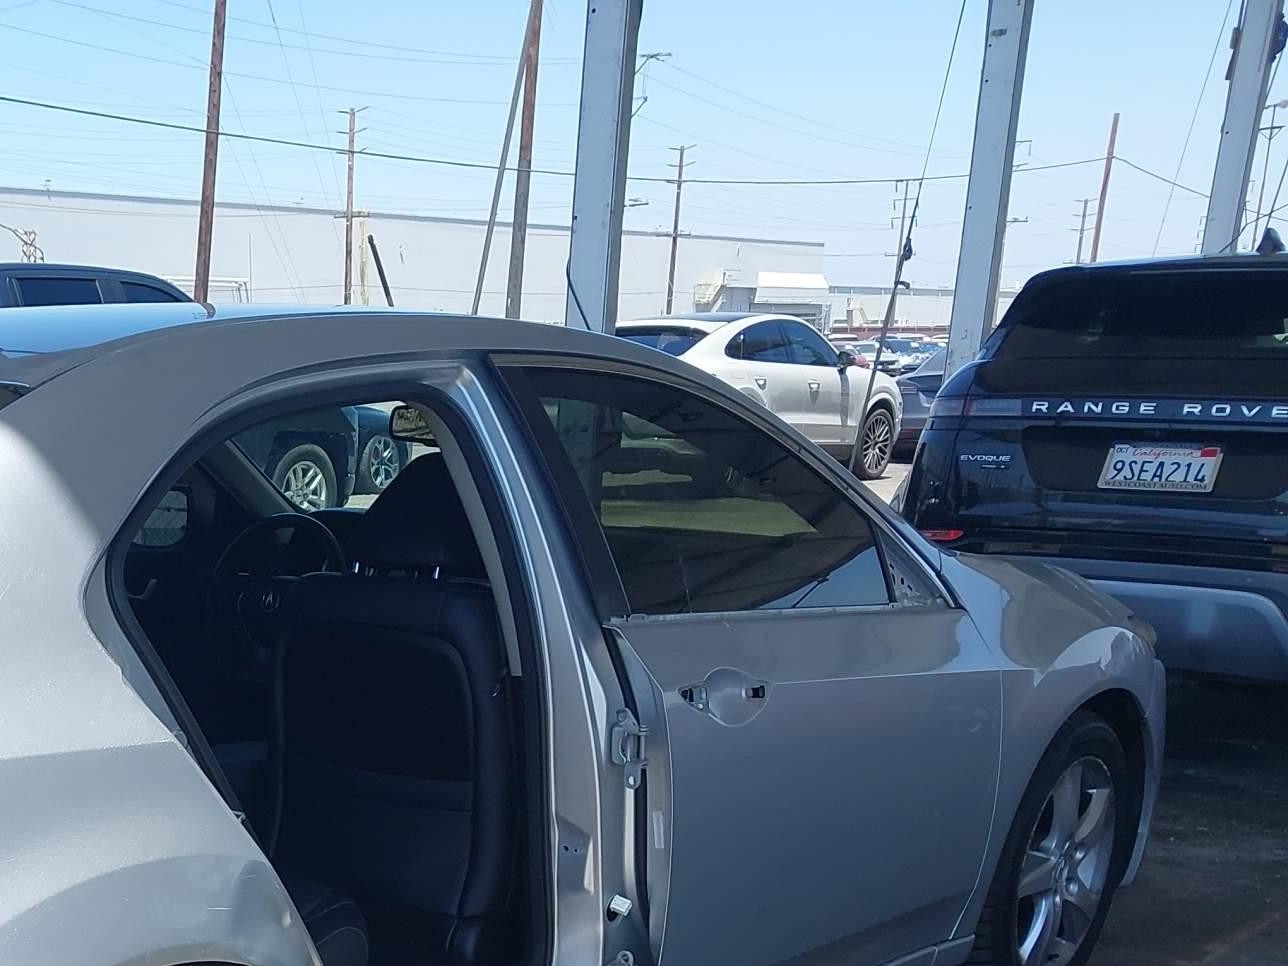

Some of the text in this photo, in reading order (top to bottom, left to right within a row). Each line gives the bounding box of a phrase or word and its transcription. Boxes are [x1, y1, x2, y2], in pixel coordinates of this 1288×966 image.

[1031, 401, 1288, 418] RANGE ROVE
[960, 454, 1011, 462] EVOQUE
[1132, 448, 1200, 460] California
[1109, 459, 1209, 483] 9SEA214
